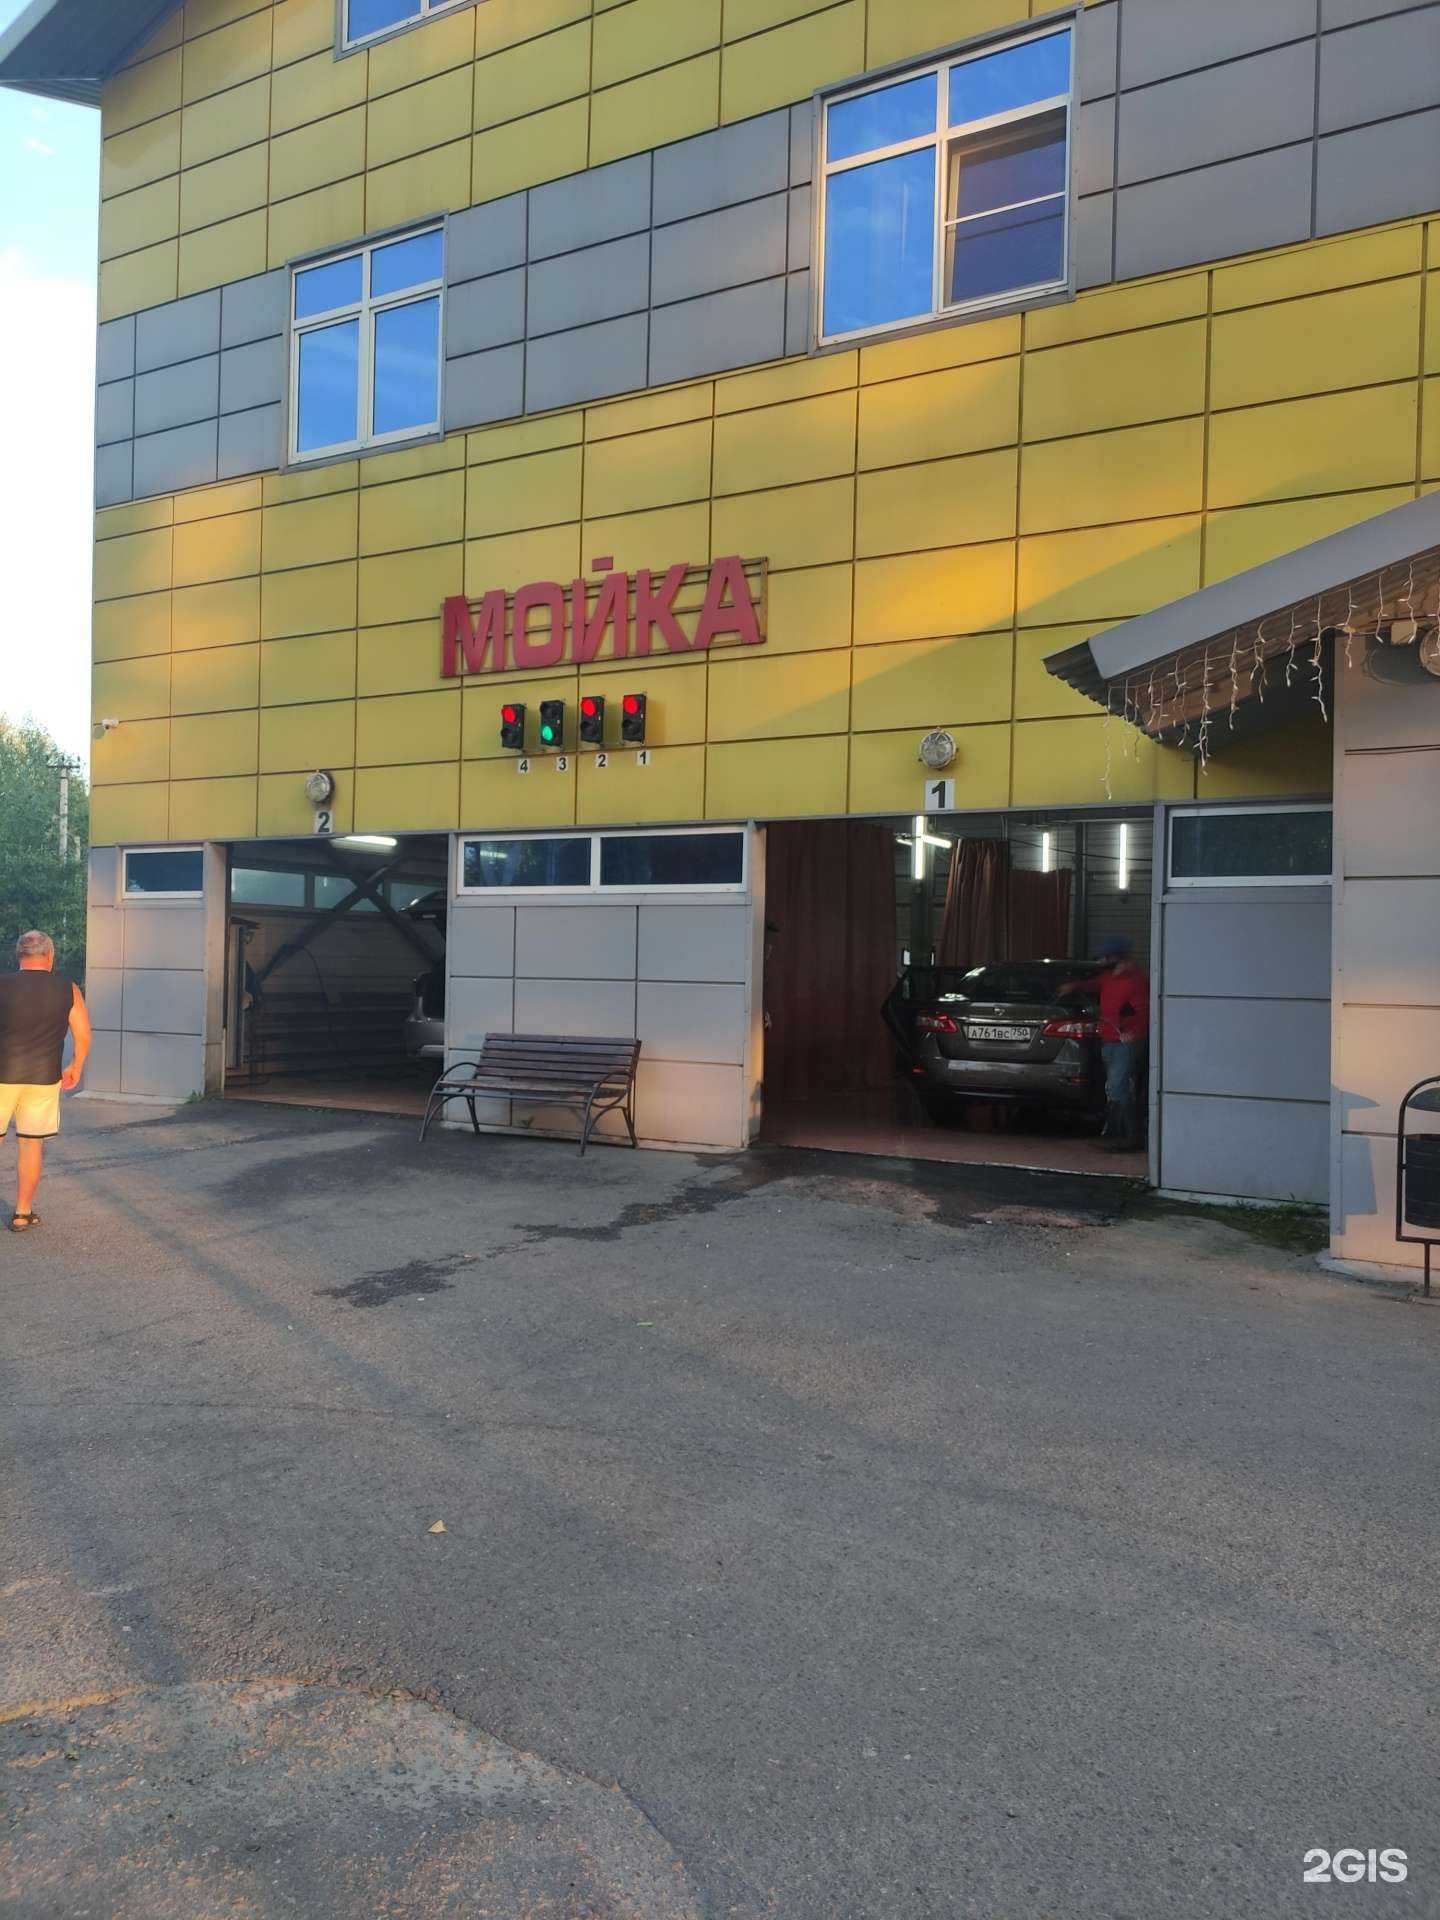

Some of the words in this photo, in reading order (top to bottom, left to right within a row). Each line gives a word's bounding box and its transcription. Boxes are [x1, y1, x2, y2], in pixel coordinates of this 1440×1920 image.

[440, 555, 763, 678] МОЙКА
[520, 759, 529, 772] 4
[558, 757, 567, 771] 3
[598, 754, 606, 767] 2
[639, 751, 647, 765] 1
[931, 780, 946, 809] 1
[318, 811, 330, 833] 2
